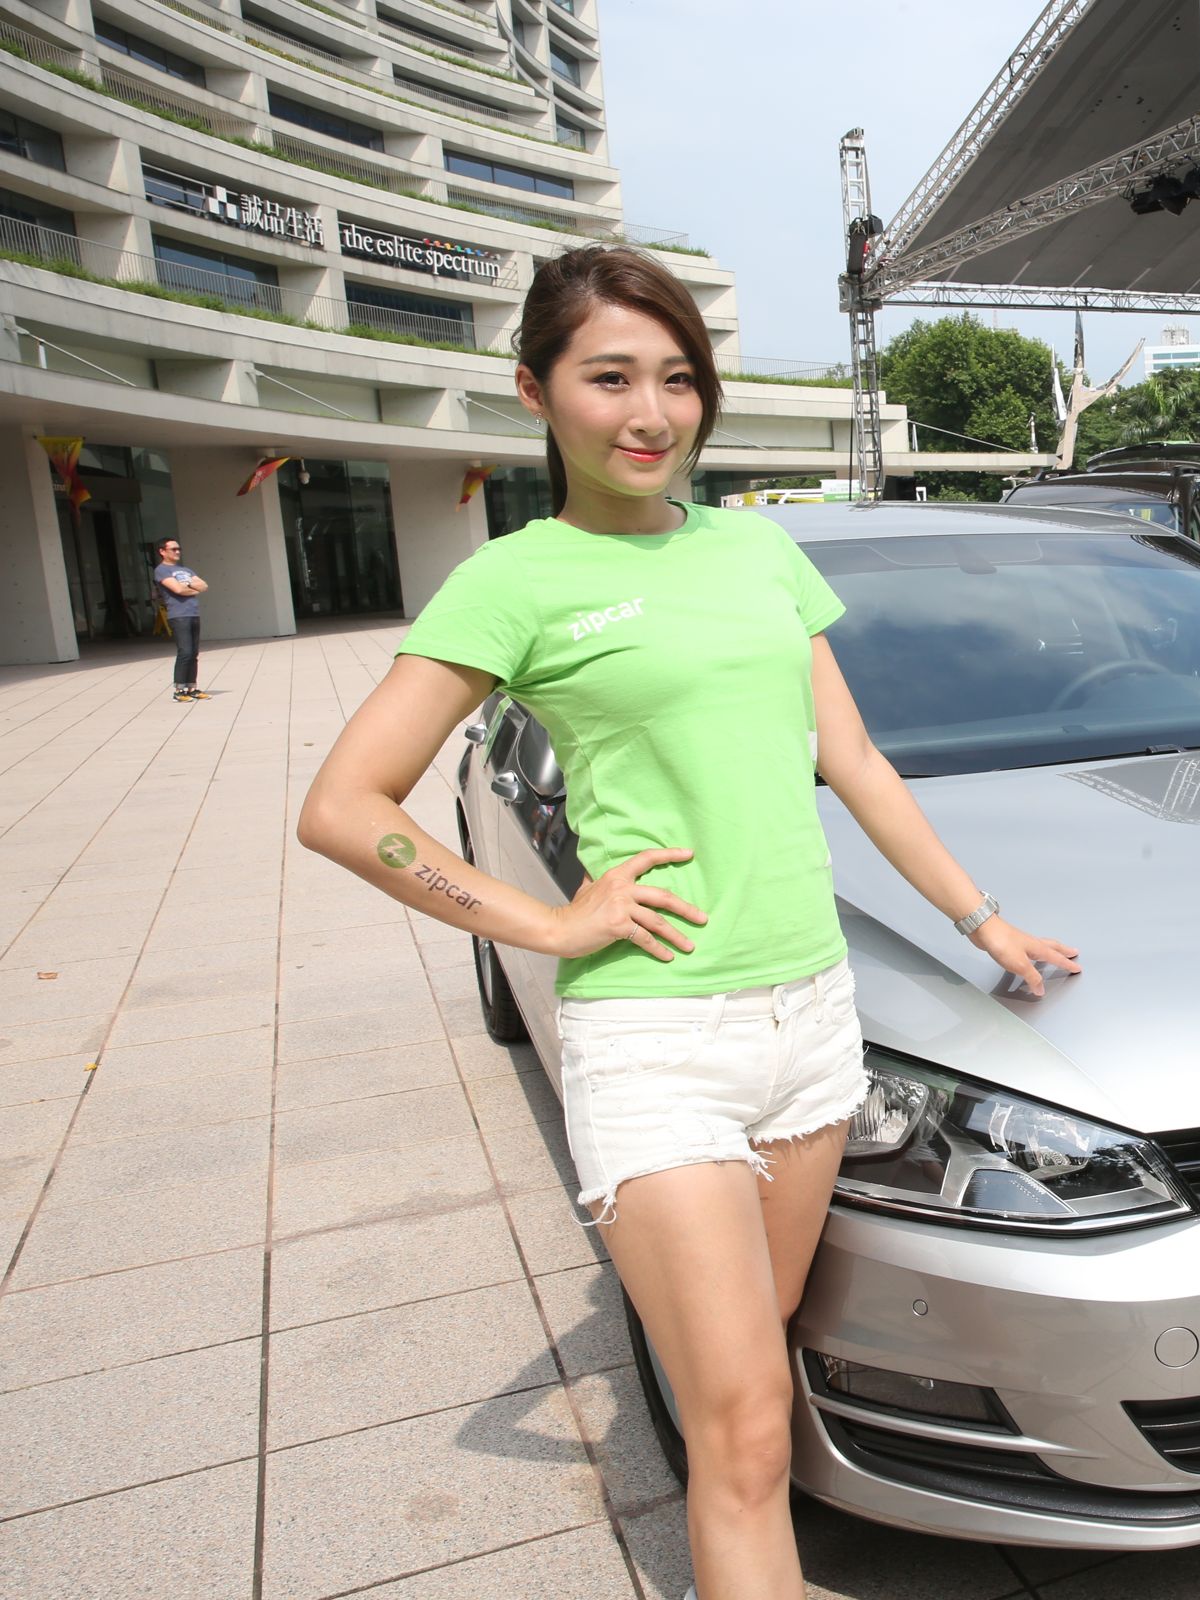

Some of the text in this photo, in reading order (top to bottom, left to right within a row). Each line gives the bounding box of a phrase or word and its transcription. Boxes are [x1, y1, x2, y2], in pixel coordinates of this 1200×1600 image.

[240, 194, 324, 246] 誠品生活
[343, 224, 500, 277] the eslite spectrum
[568, 597, 645, 642] zipcar
